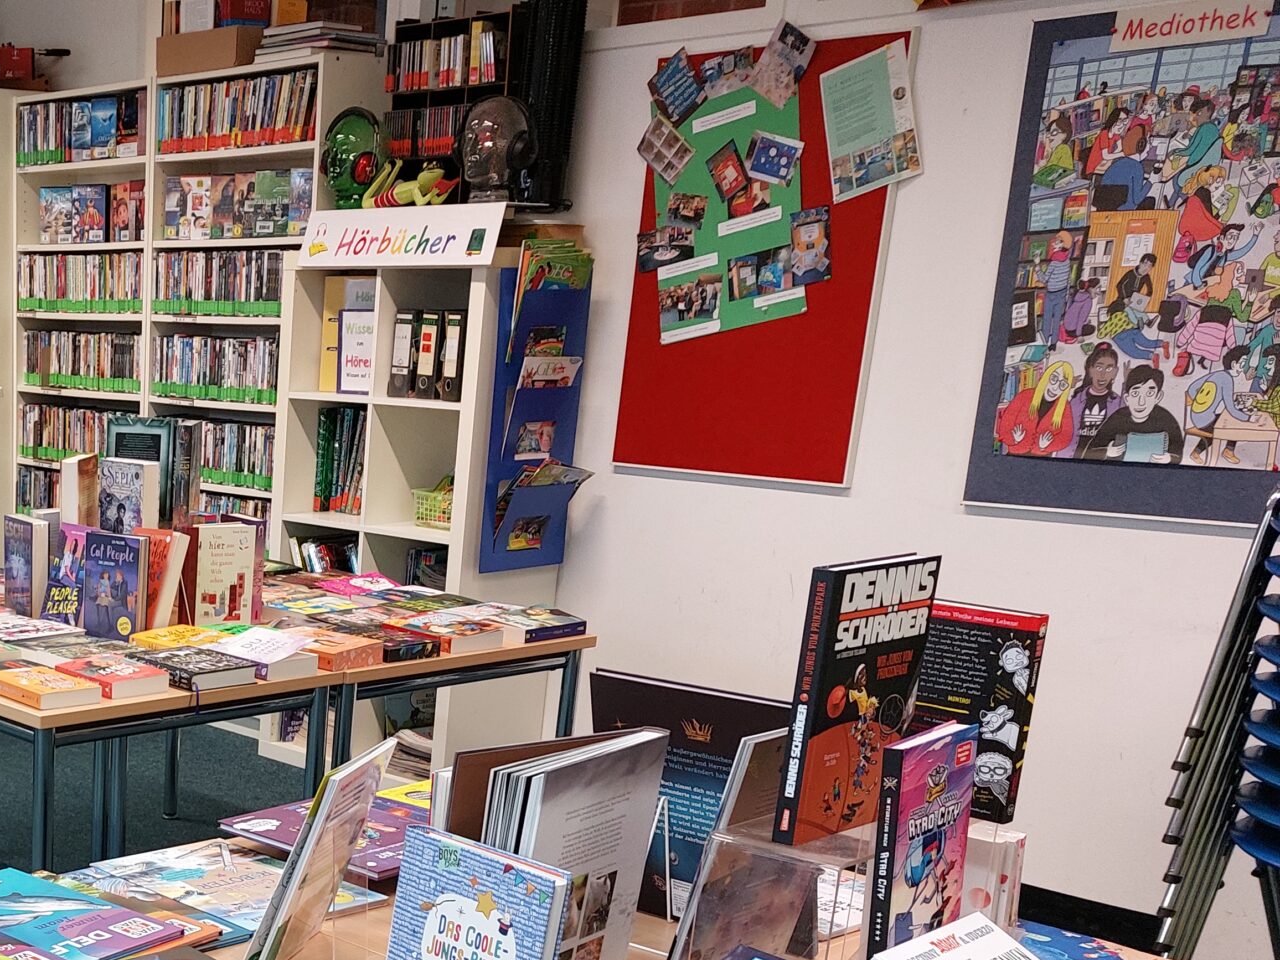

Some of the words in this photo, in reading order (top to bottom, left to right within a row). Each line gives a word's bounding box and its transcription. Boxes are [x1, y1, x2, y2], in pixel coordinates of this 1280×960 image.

[1122, 5, 1257, 41] Mediothek
[334, 224, 456, 257] Hörbücher
[345, 322, 373, 335] Wisse
[107, 465, 136, 487] SEPIA
[90, 544, 104, 558] Cat
[107, 546, 135, 566] People
[209, 541, 225, 550] hier
[50, 587, 79, 600] PEOPLE
[840, 560, 938, 614] DENNIS
[46, 601, 79, 614] PLEASER
[834, 605, 930, 651] SCHRÖDER
[790, 704, 808, 759] SCHRÖDER
[784, 757, 800, 798] DENNIS
[908, 809, 935, 841] ATRO
[936, 802, 962, 830] CITY
[439, 848, 458, 861] BOYS
[438, 914, 462, 942] DAS
[465, 926, 508, 959] COOLE-
[969, 925, 994, 942] UDERZO
